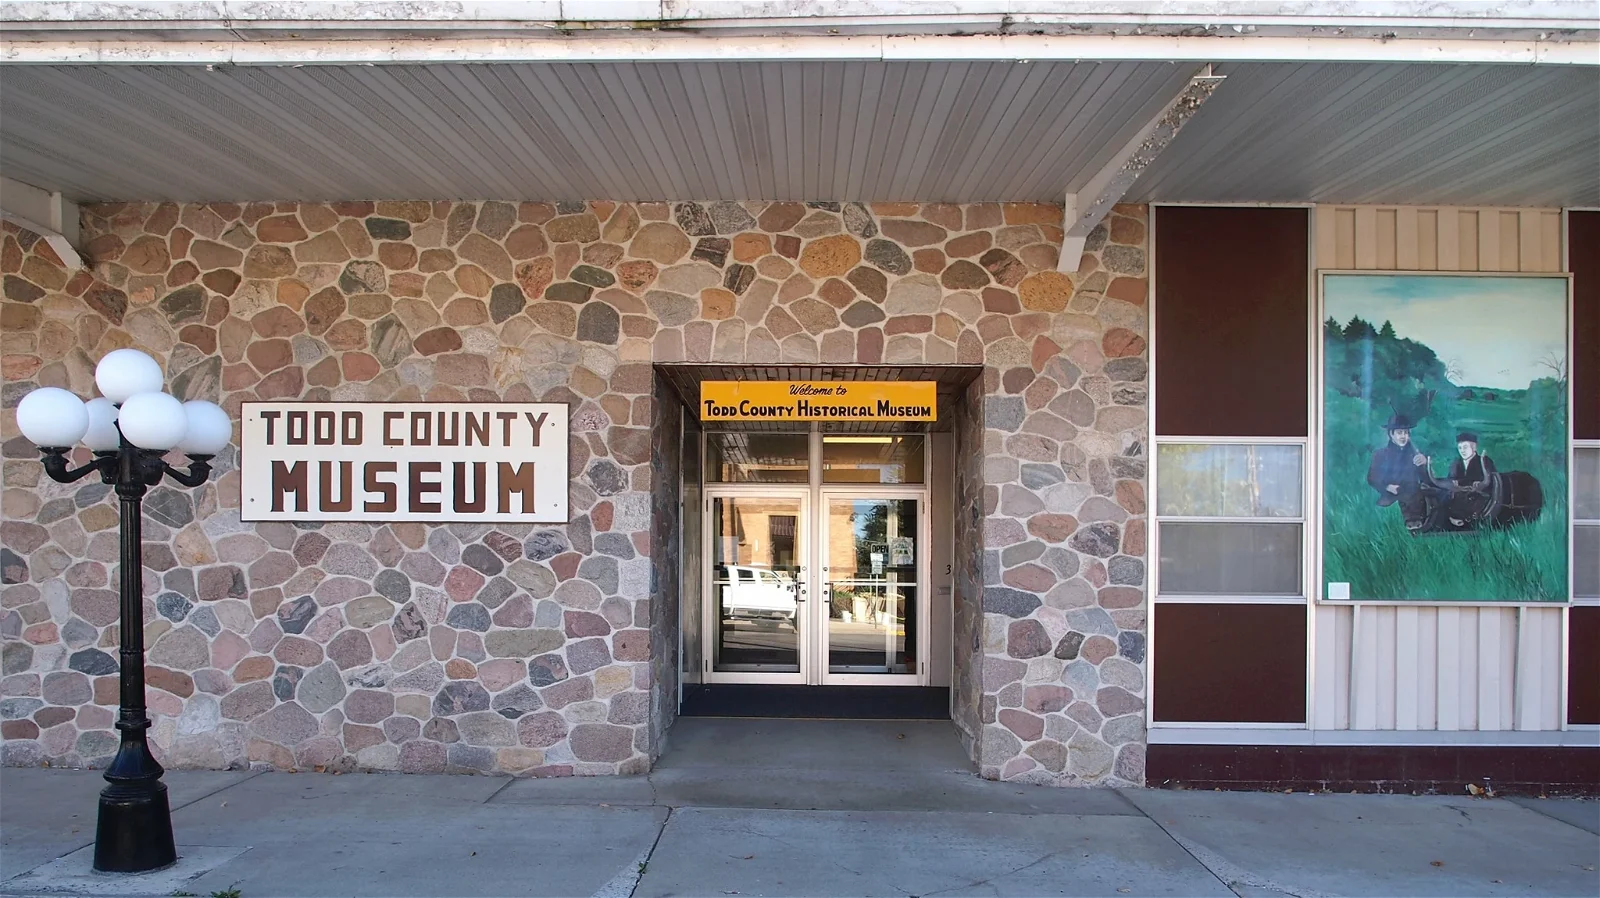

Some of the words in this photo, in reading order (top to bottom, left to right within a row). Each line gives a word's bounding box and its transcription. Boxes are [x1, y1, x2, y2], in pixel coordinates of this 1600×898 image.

[790, 384, 833, 396] Welcome
[835, 385, 847, 395] to
[704, 400, 737, 416] TODD
[740, 400, 794, 416] COUNTY
[797, 400, 874, 416] HISTORICAL
[877, 400, 931, 416] MUSEUM
[260, 411, 363, 445] TODD
[383, 411, 549, 447] COUNTY
[270, 460, 536, 514] MUSEUM
[872, 545, 889, 553] OPEN
